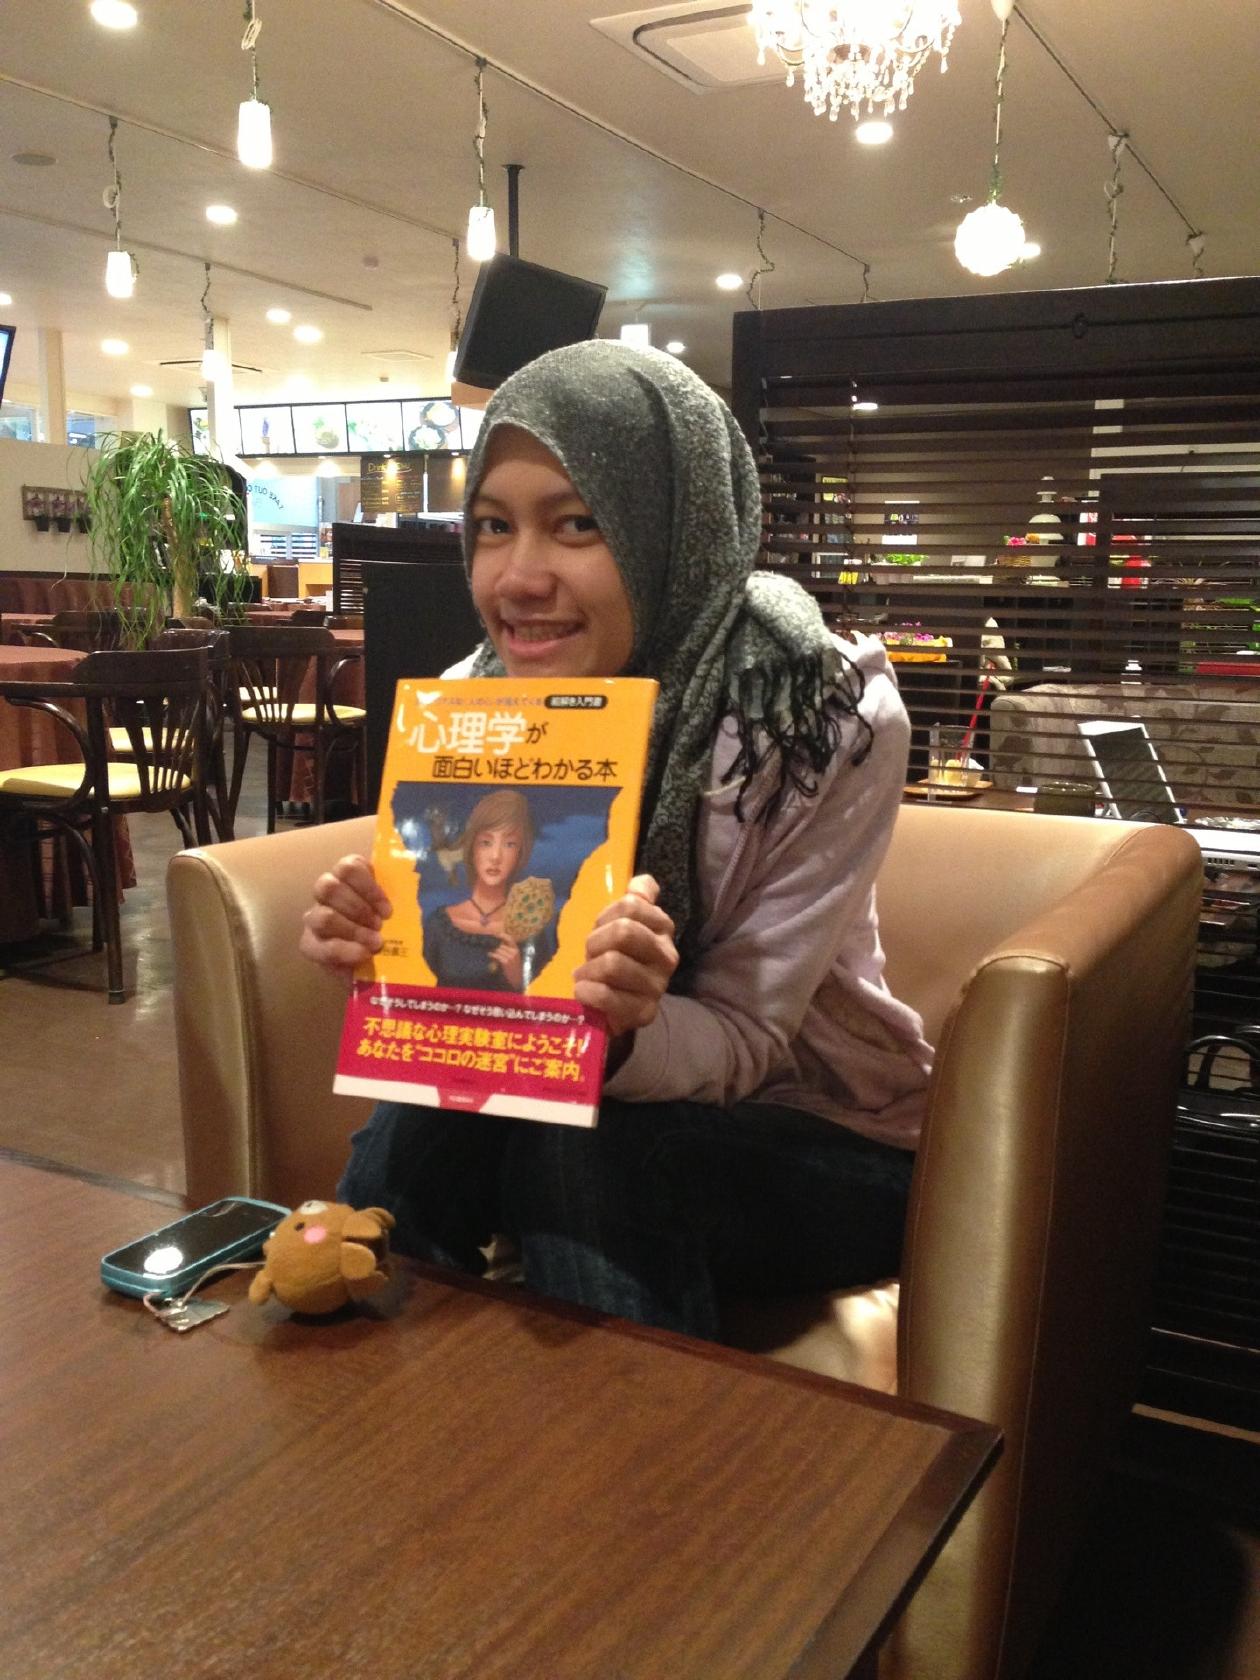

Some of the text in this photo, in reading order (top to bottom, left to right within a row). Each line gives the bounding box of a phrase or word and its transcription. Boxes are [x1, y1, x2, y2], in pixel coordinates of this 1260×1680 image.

[408, 710, 549, 755] 心理学が
[432, 755, 618, 781] 面白いほどわかる本
